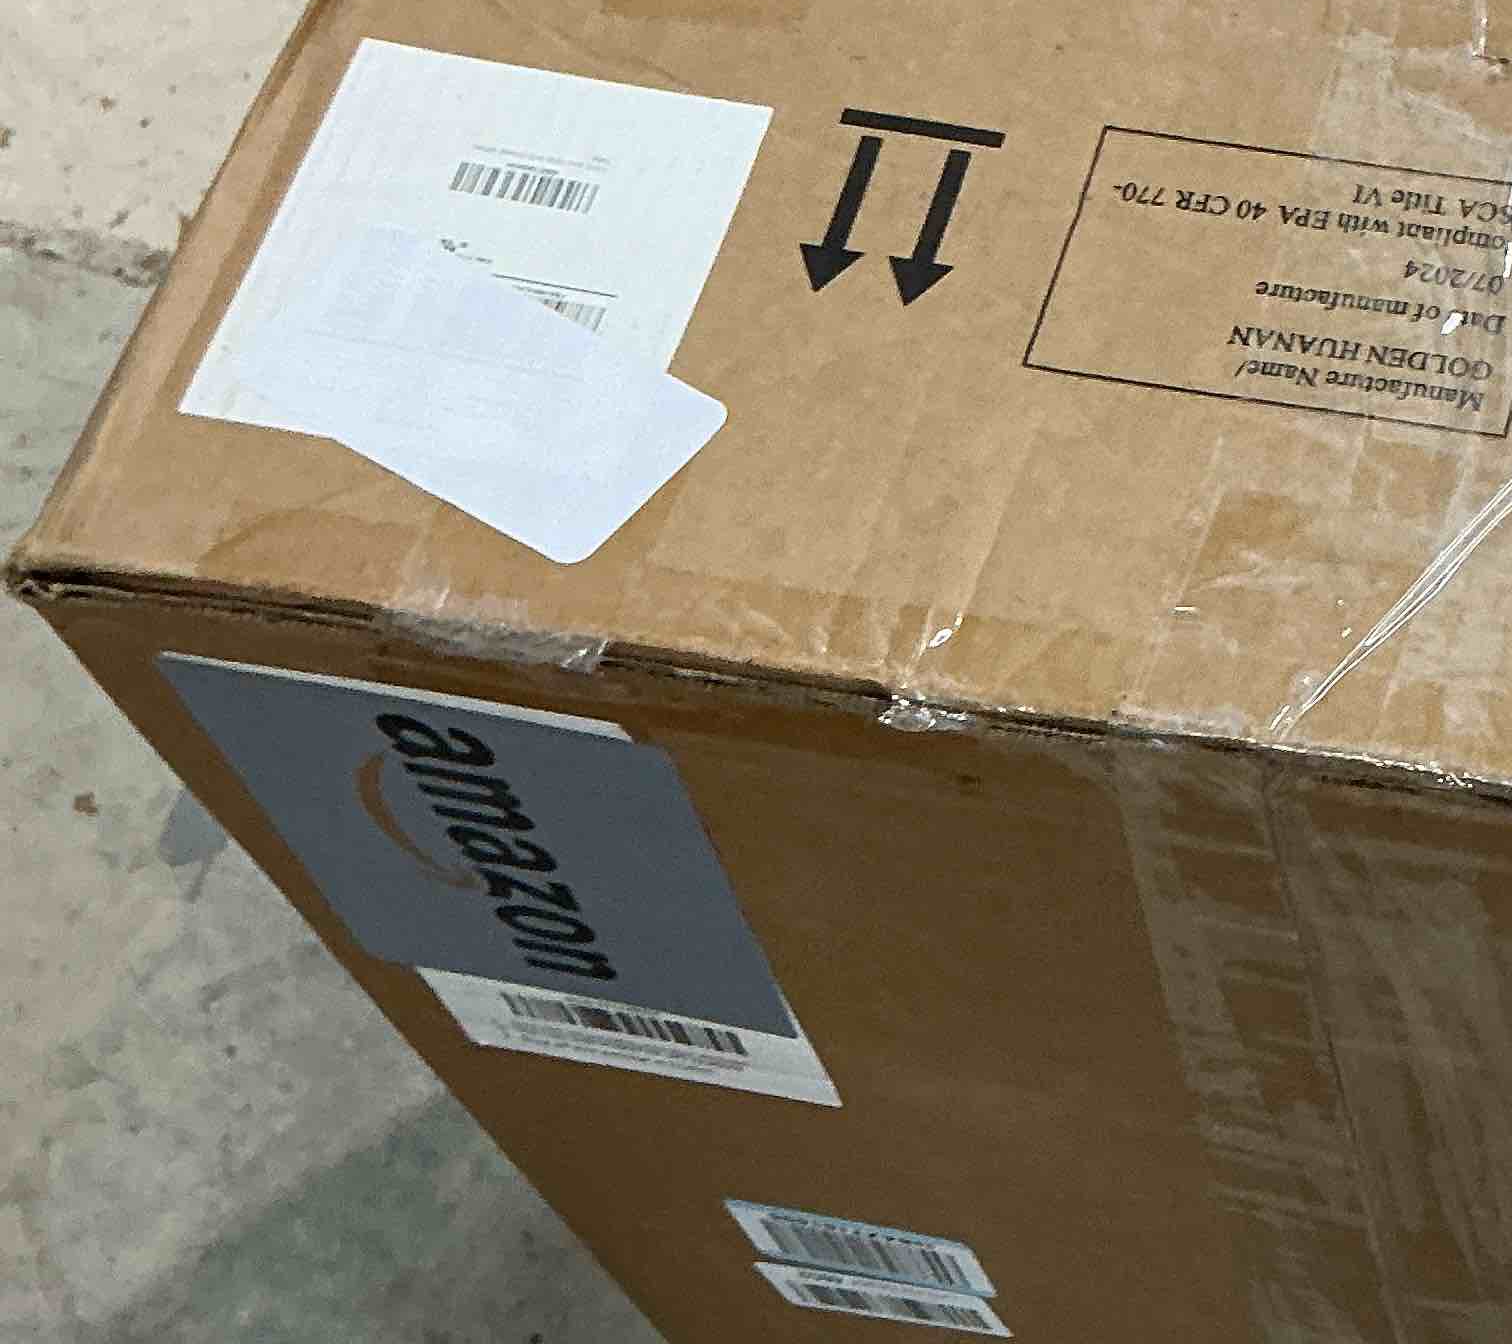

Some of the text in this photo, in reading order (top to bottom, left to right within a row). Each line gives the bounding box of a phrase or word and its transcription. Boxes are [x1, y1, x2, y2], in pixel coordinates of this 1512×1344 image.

[1175, 190, 1231, 215] CFR
[1352, 184, 1383, 206] VI
[1392, 189, 1446, 216] Title
[1236, 199, 1267, 220] 40
[1279, 205, 1330, 230] EPA
[1338, 211, 1389, 233] with
[1403, 260, 1504, 295] 07/2024
[1255, 280, 1408, 315] manufacture
[1410, 303, 1440, 322] of
[1226, 325, 1493, 380] GOLDEN HUANAN
[1326, 370, 1484, 411] Manufacture
[375, 712, 618, 981] amazon
